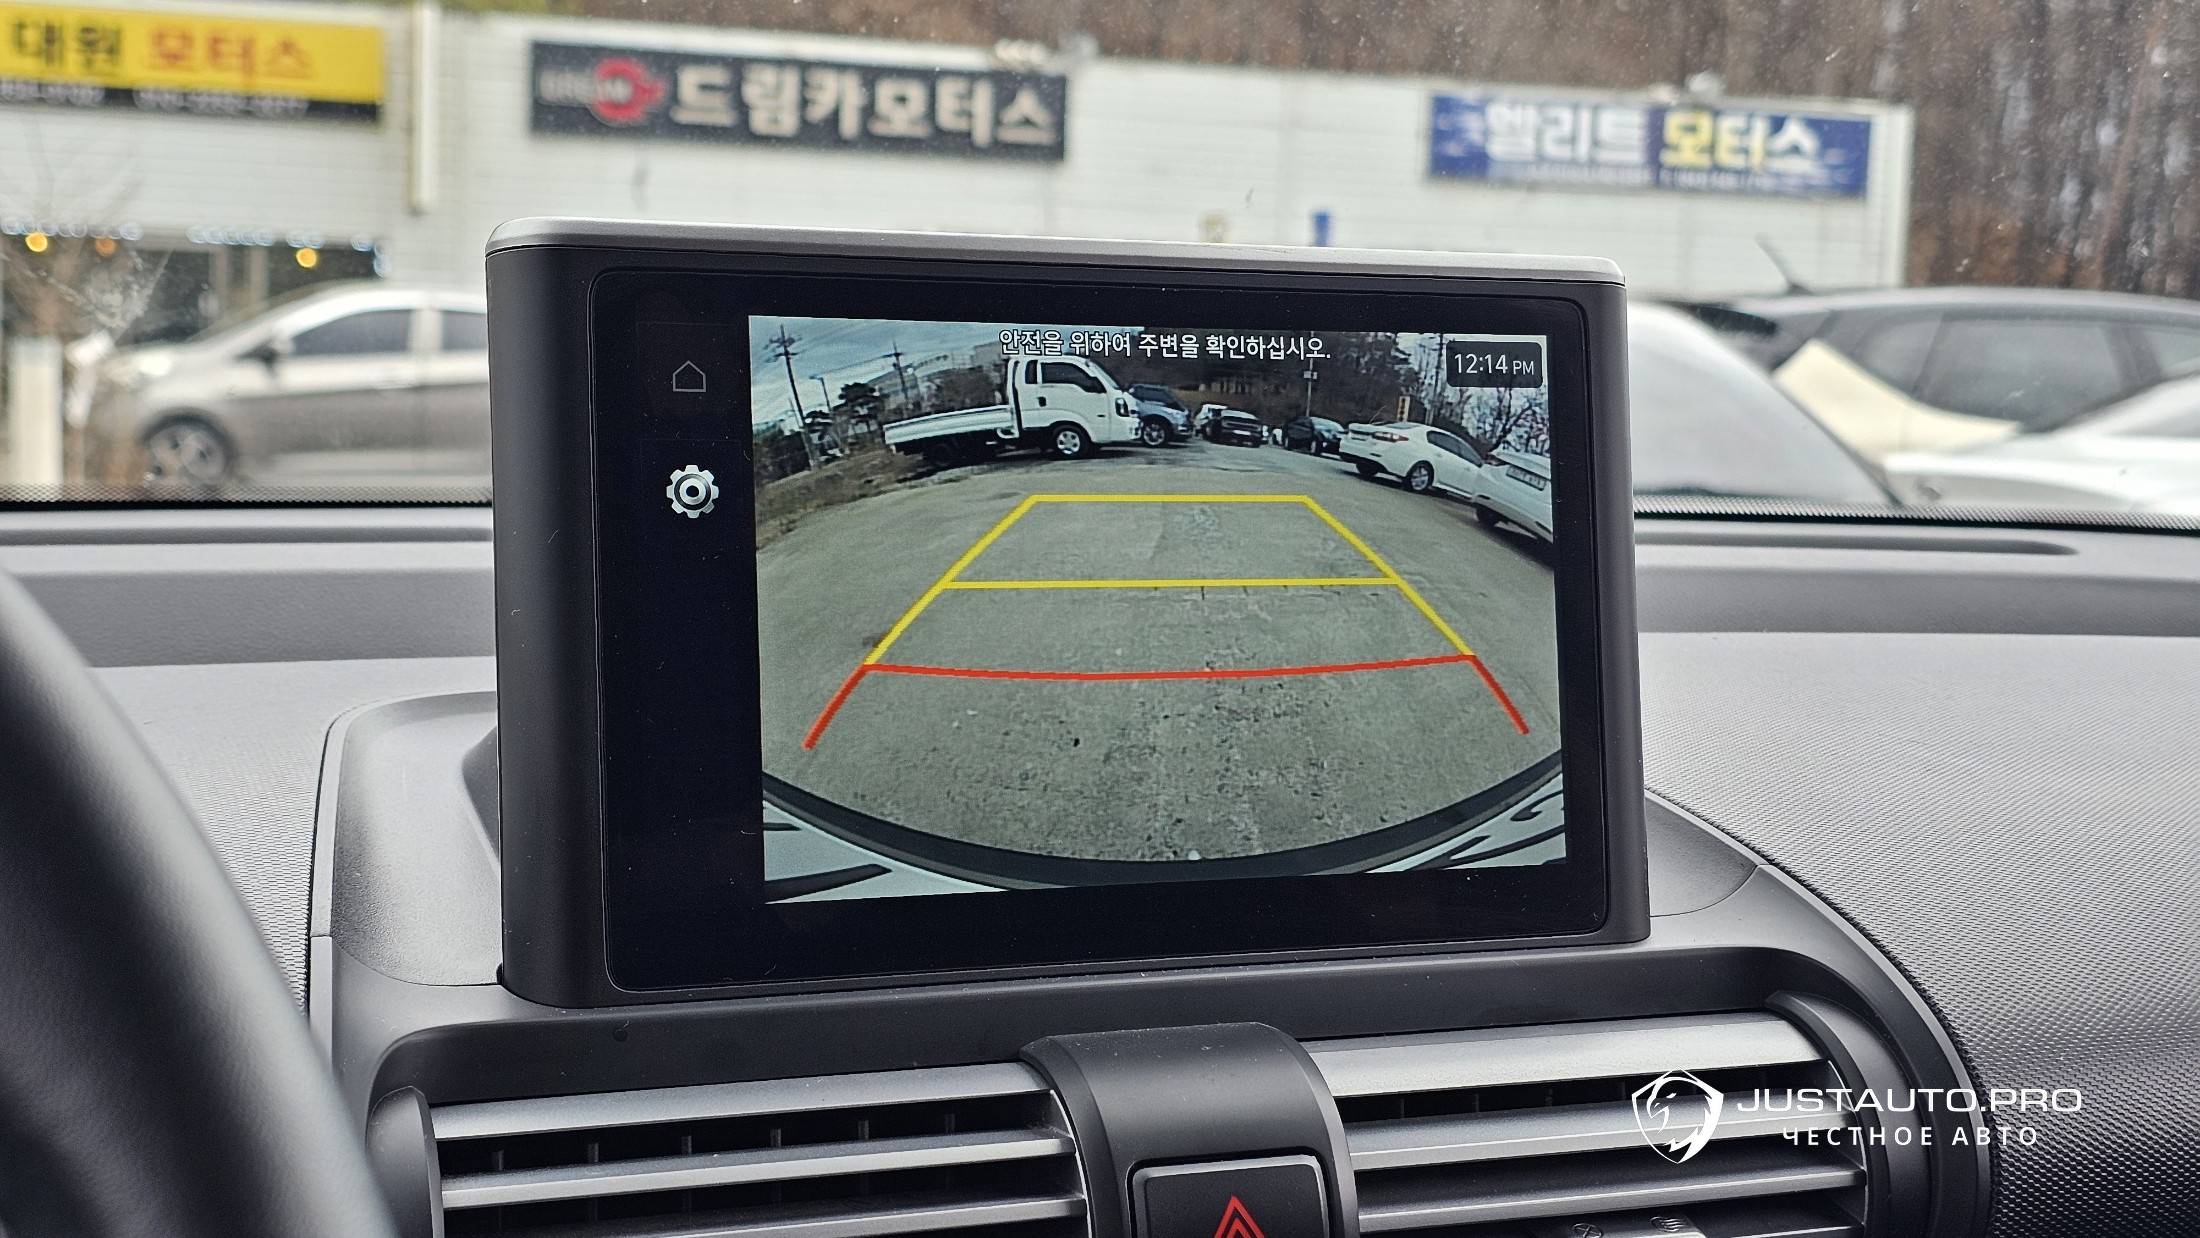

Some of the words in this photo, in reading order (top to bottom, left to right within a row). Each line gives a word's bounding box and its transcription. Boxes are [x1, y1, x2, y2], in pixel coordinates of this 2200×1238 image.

[143, 23, 317, 84] 모터스
[669, 62, 1058, 148] 드림카모터스
[1660, 110, 1826, 175] 모터스
[999, 329, 1063, 355] 안전을
[1069, 331, 1131, 357] 위하여
[1138, 333, 1199, 359] 주변을
[1205, 334, 1331, 361] 확인하십시오.
[1454, 353, 1508, 374] 12:14
[1512, 360, 1534, 375] PM
